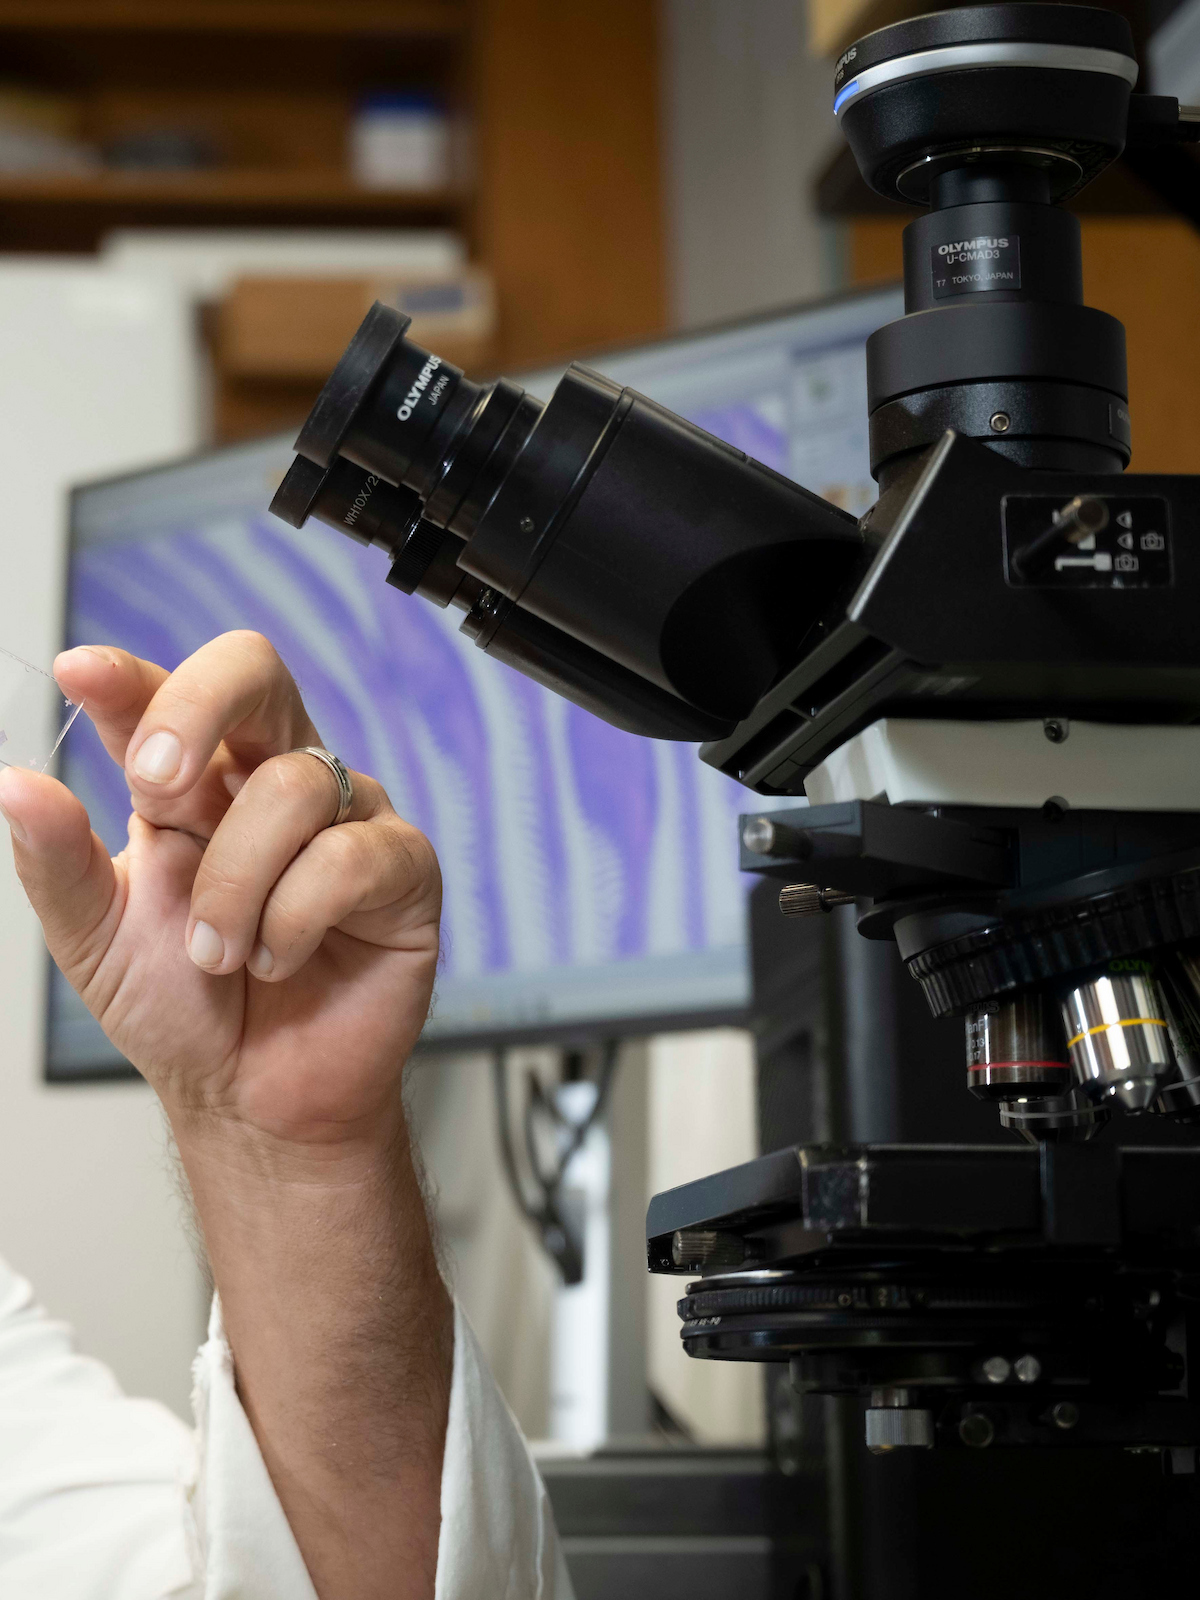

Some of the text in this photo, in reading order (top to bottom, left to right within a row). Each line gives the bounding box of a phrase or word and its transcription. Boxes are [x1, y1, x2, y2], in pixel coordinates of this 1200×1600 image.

[938, 238, 1009, 255] OLYMPUS
[947, 250, 1000, 264] U-CMAD3
[985, 272, 1014, 280] JAPAN
[397, 355, 441, 421] OLYMPUS
[428, 375, 449, 405] JAPAN
[344, 474, 380, 526] WH10X/2
